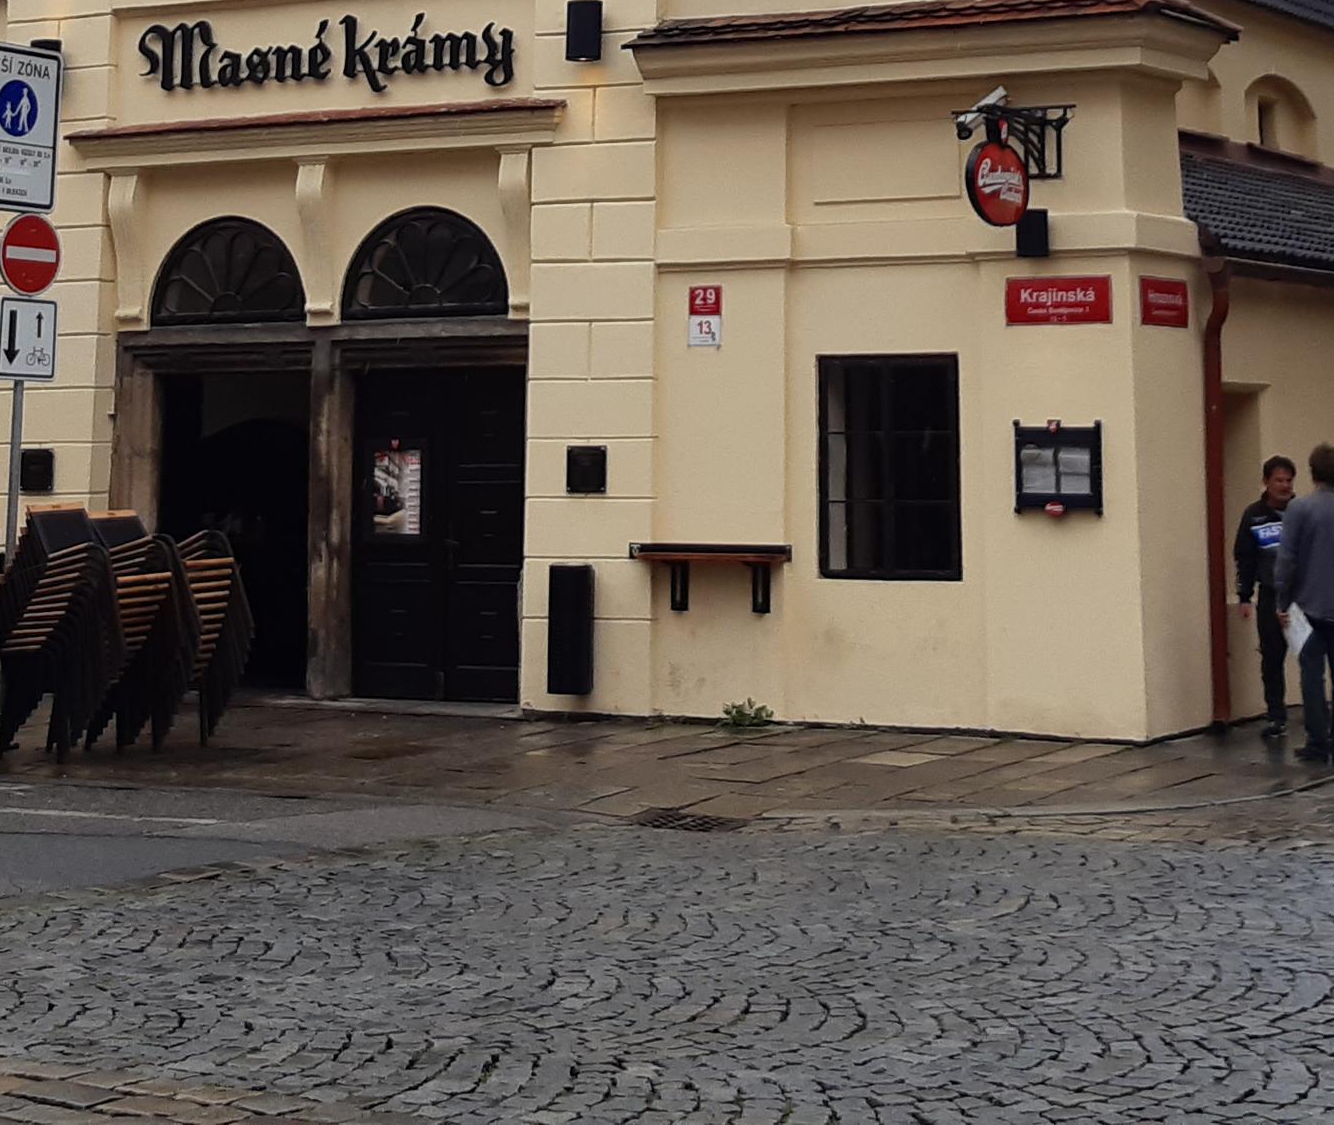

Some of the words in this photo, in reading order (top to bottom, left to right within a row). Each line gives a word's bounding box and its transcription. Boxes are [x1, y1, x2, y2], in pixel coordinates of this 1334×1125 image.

[138, 19, 332, 92] Masné
[17, 59, 51, 80] ZÓNA
[694, 289, 716, 305] 29
[1019, 285, 1096, 306] Krajinská
[697, 320, 712, 335] 13
